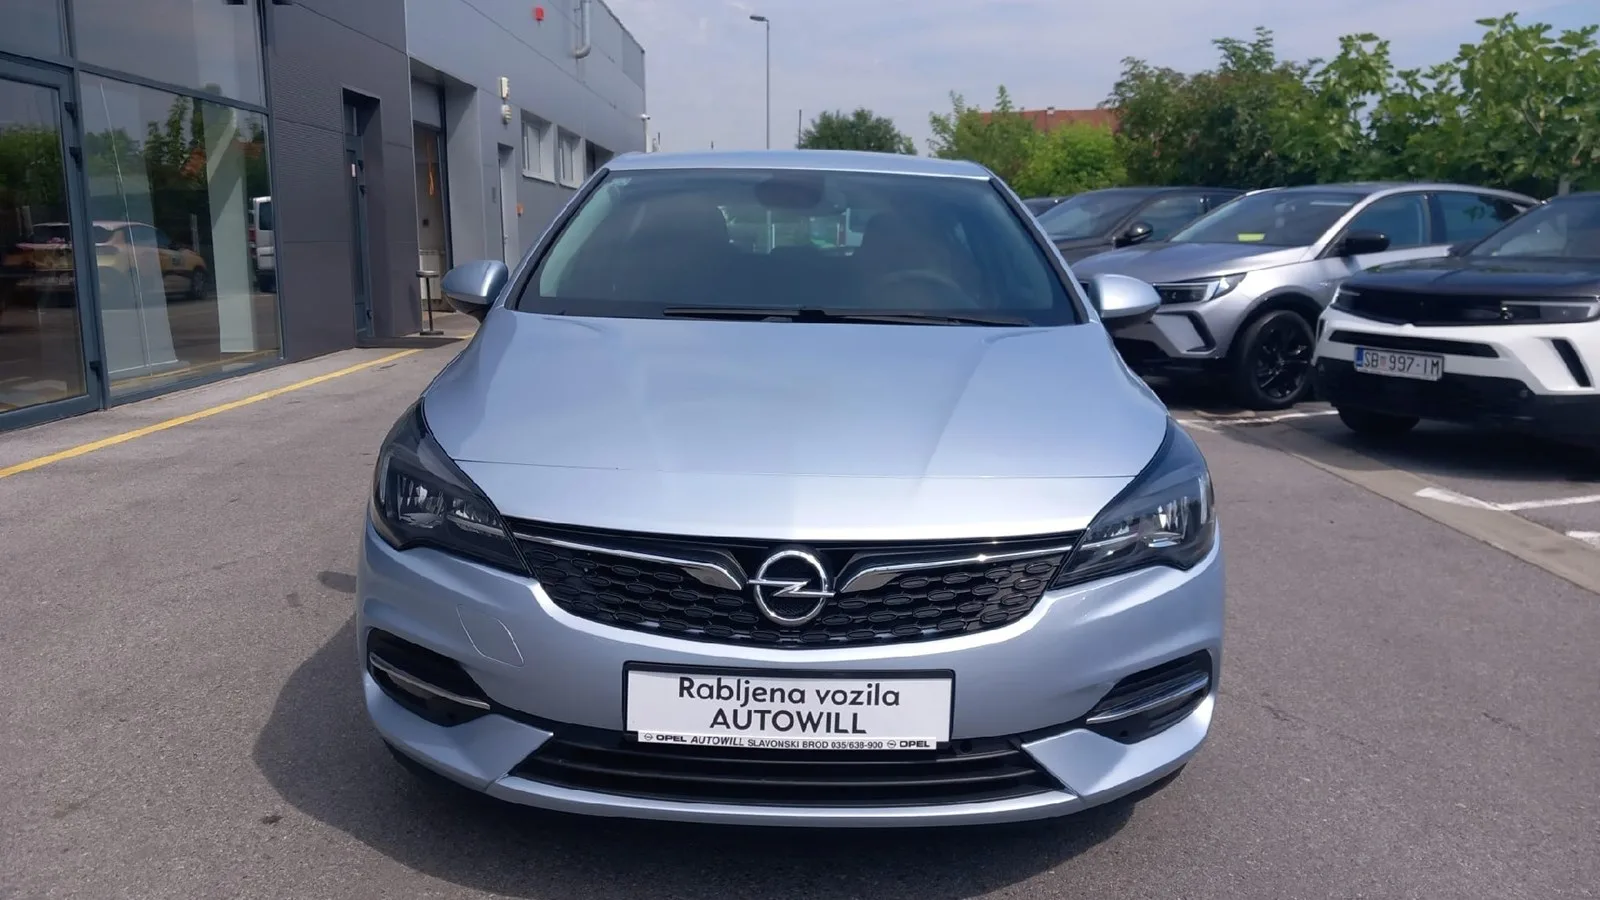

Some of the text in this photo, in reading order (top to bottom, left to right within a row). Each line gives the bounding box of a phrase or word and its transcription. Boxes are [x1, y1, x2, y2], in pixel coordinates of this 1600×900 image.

[1364, 351, 1379, 368] SB
[678, 676, 900, 708] Rabljena vozila
[709, 707, 867, 734] AUTOWILL
[656, 734, 687, 742] OPEL
[690, 735, 744, 746] AUTOWILL
[747, 739, 800, 748] SLAVONSKI
[802, 740, 829, 749] BROD
[899, 740, 930, 748] OPEL
